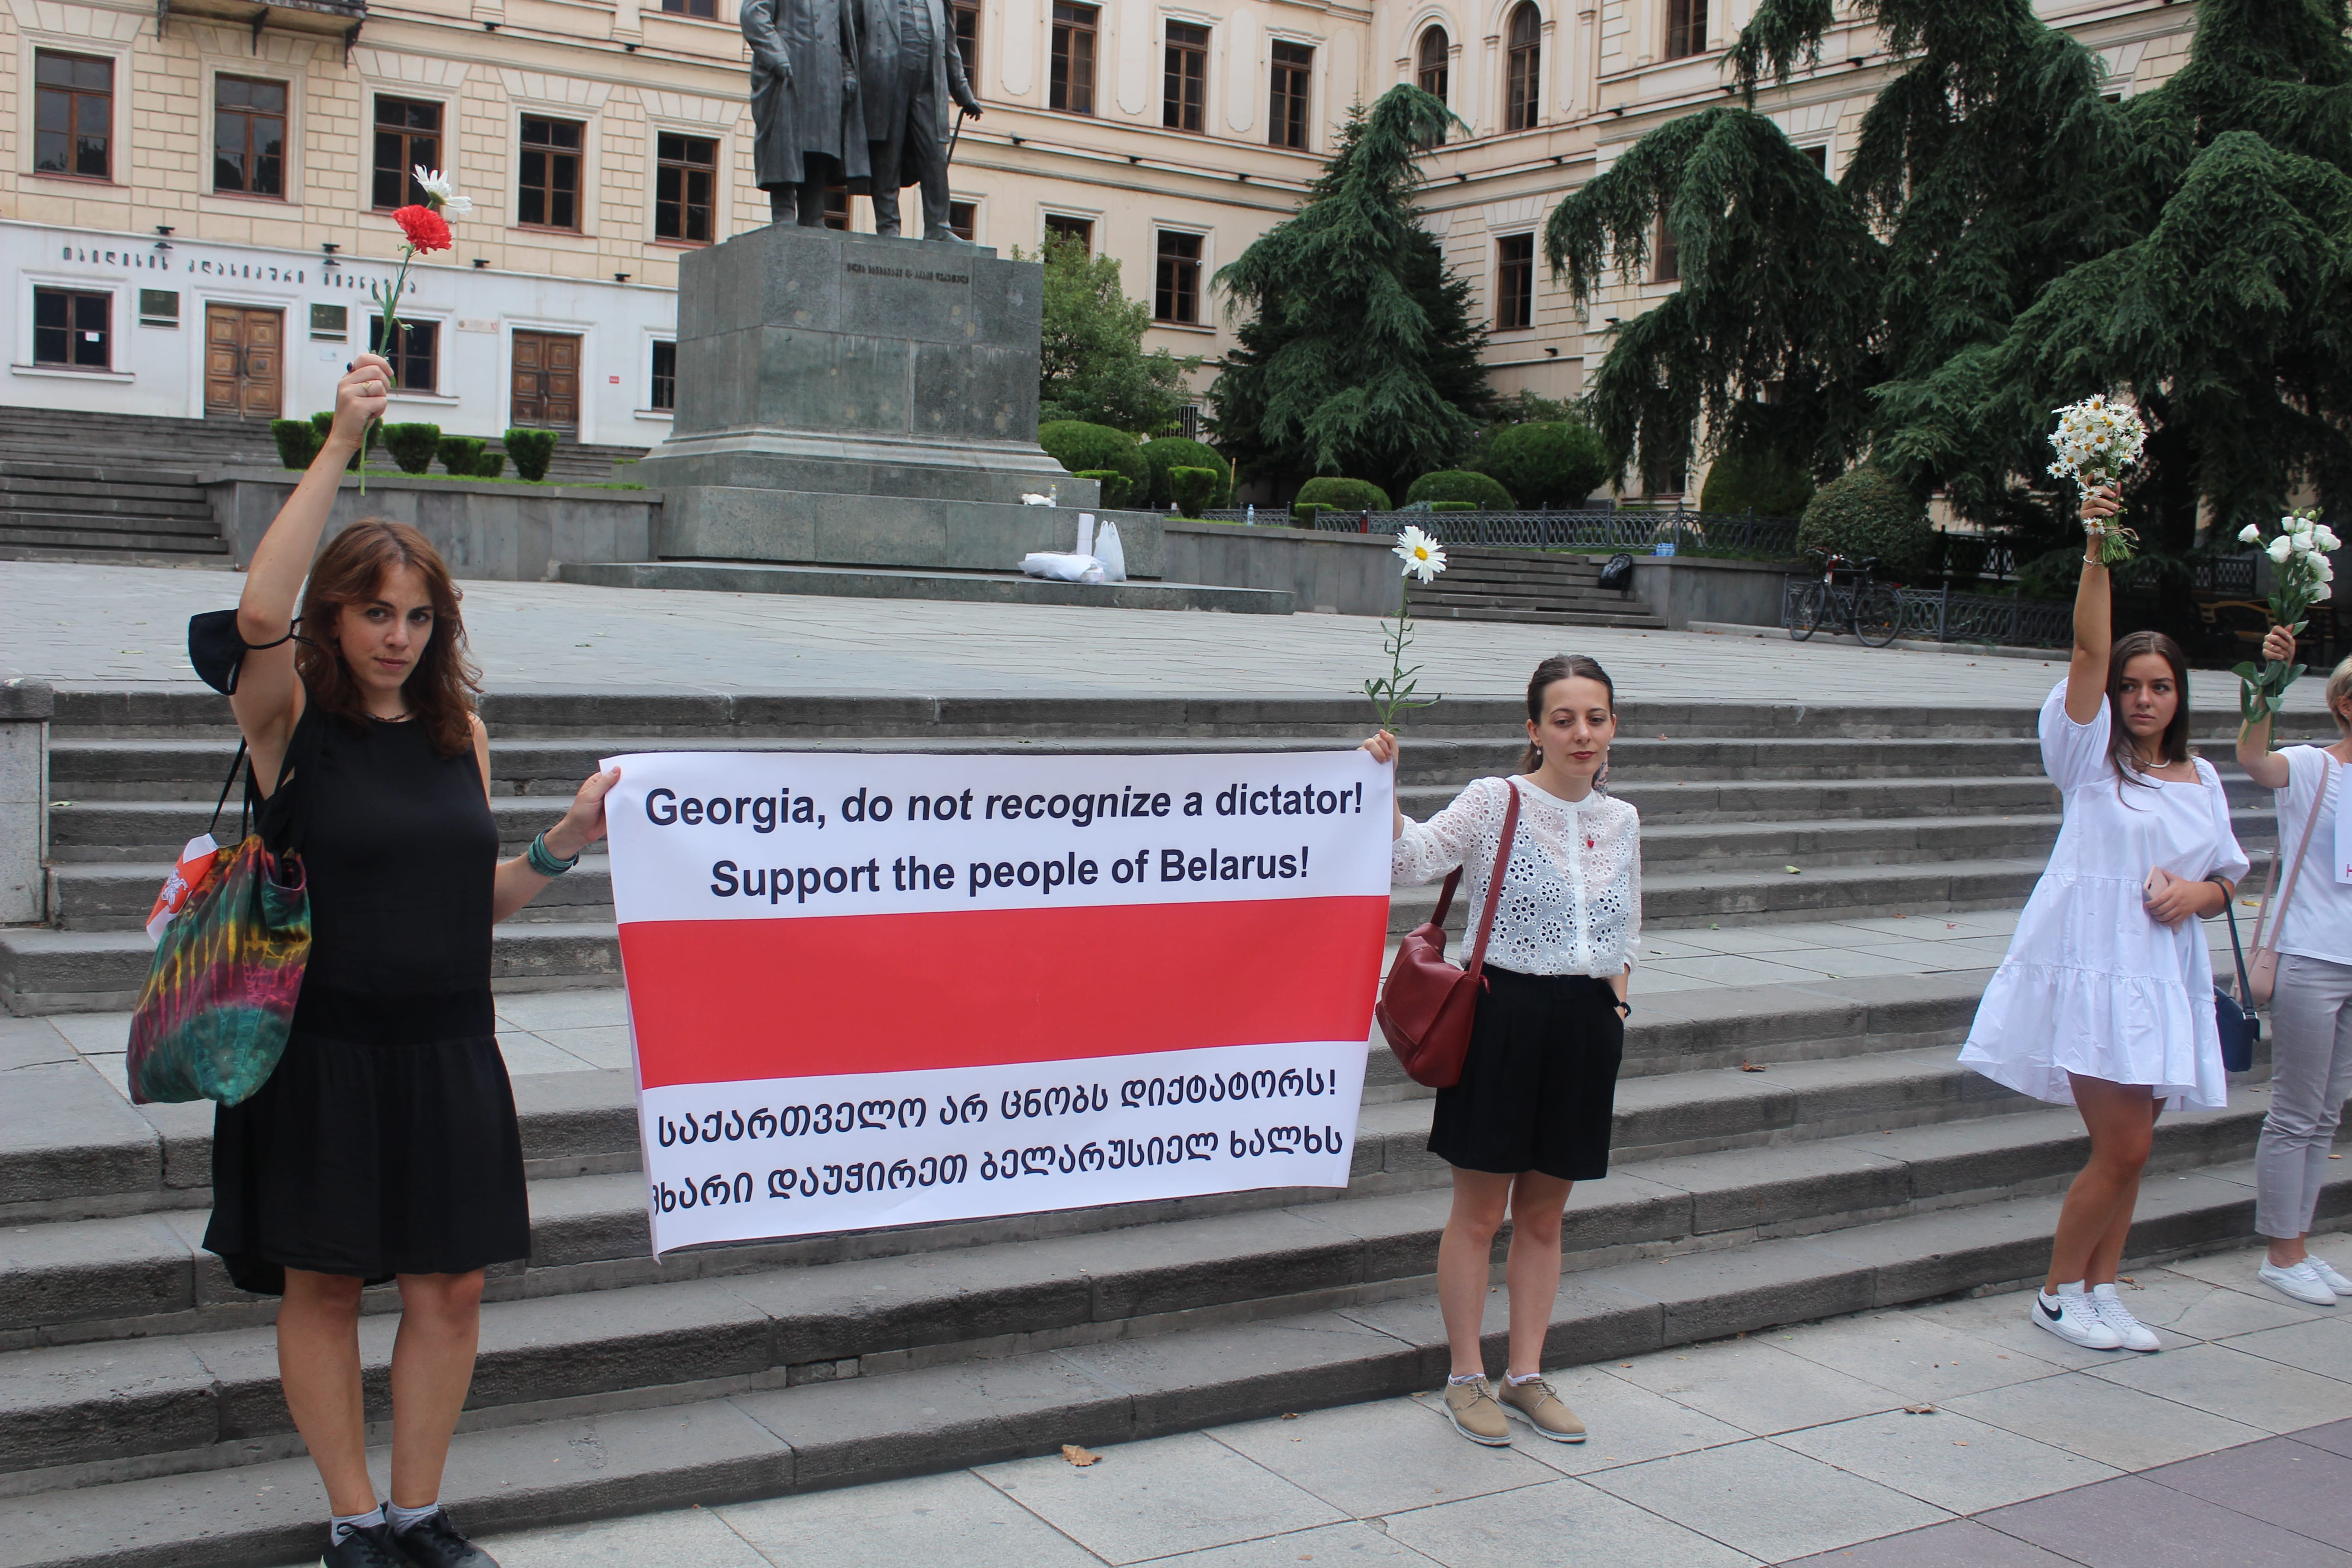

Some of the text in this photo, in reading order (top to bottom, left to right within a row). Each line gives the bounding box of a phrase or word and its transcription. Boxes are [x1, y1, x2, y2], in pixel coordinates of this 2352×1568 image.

[64, 247, 168, 271] თბილისის
[645, 781, 1362, 834] Georgia, do not recognize a dictator!
[710, 845, 1309, 905] Support the people of Belarus!
[658, 1067, 1336, 1148] საქართველო არ ცნობს დიქტატორს!
[767, 1153, 968, 1200] დაუჭირეთ
[980, 1132, 1219, 1181] ბელარუსიელ
[1230, 1125, 1343, 1159] ხალხს
